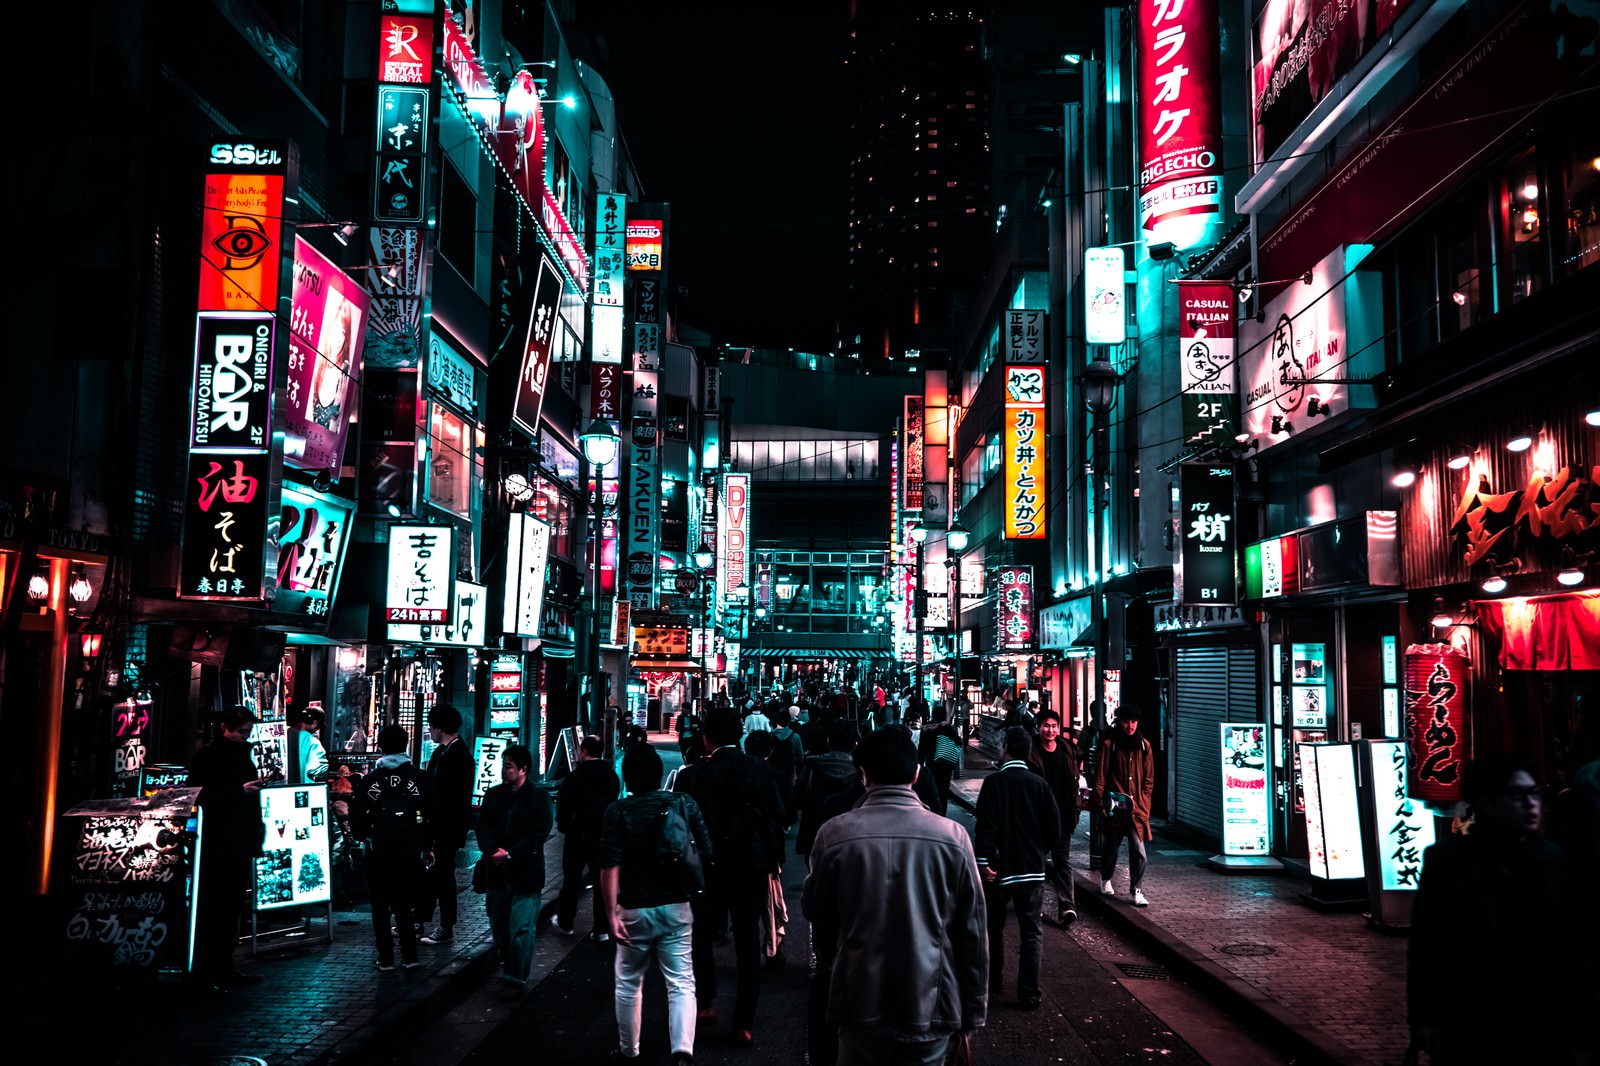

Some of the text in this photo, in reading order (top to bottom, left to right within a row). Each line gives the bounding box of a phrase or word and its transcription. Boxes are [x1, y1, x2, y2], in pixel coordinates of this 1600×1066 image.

[1152, 0, 1191, 146] カラオケ
[210, 144, 282, 165] SSビル
[1162, 146, 1206, 159] Entertainment
[1141, 151, 1216, 188] BIG ECHO
[226, 291, 252, 299] BAR
[1186, 300, 1229, 309] CASUAL
[1186, 313, 1229, 321] ITALIAN
[253, 325, 269, 393] ONIGIRI &
[211, 335, 253, 432] BAR
[599, 366, 614, 412] バラの木
[634, 383, 657, 399] 梅
[1010, 371, 1041, 400] かつや
[1187, 382, 1231, 391] ITALIAN
[1246, 382, 1271, 406] CASUAL
[195, 364, 213, 443] HIROMATSU
[1197, 402, 1222, 418] 2F
[250, 427, 263, 445] 2F
[1015, 410, 1038, 536] カツ丼・とんかつ
[634, 448, 652, 543] RAKUEN
[197, 460, 259, 574] 油そば
[1187, 513, 1231, 542] 梢
[1199, 545, 1223, 553] kozue
[197, 578, 246, 595] 春日亭
[1201, 588, 1218, 598] B1
[390, 608, 443, 621] 24h営業
[1419, 662, 1460, 786] らーめん
[114, 745, 147, 773] BAR
